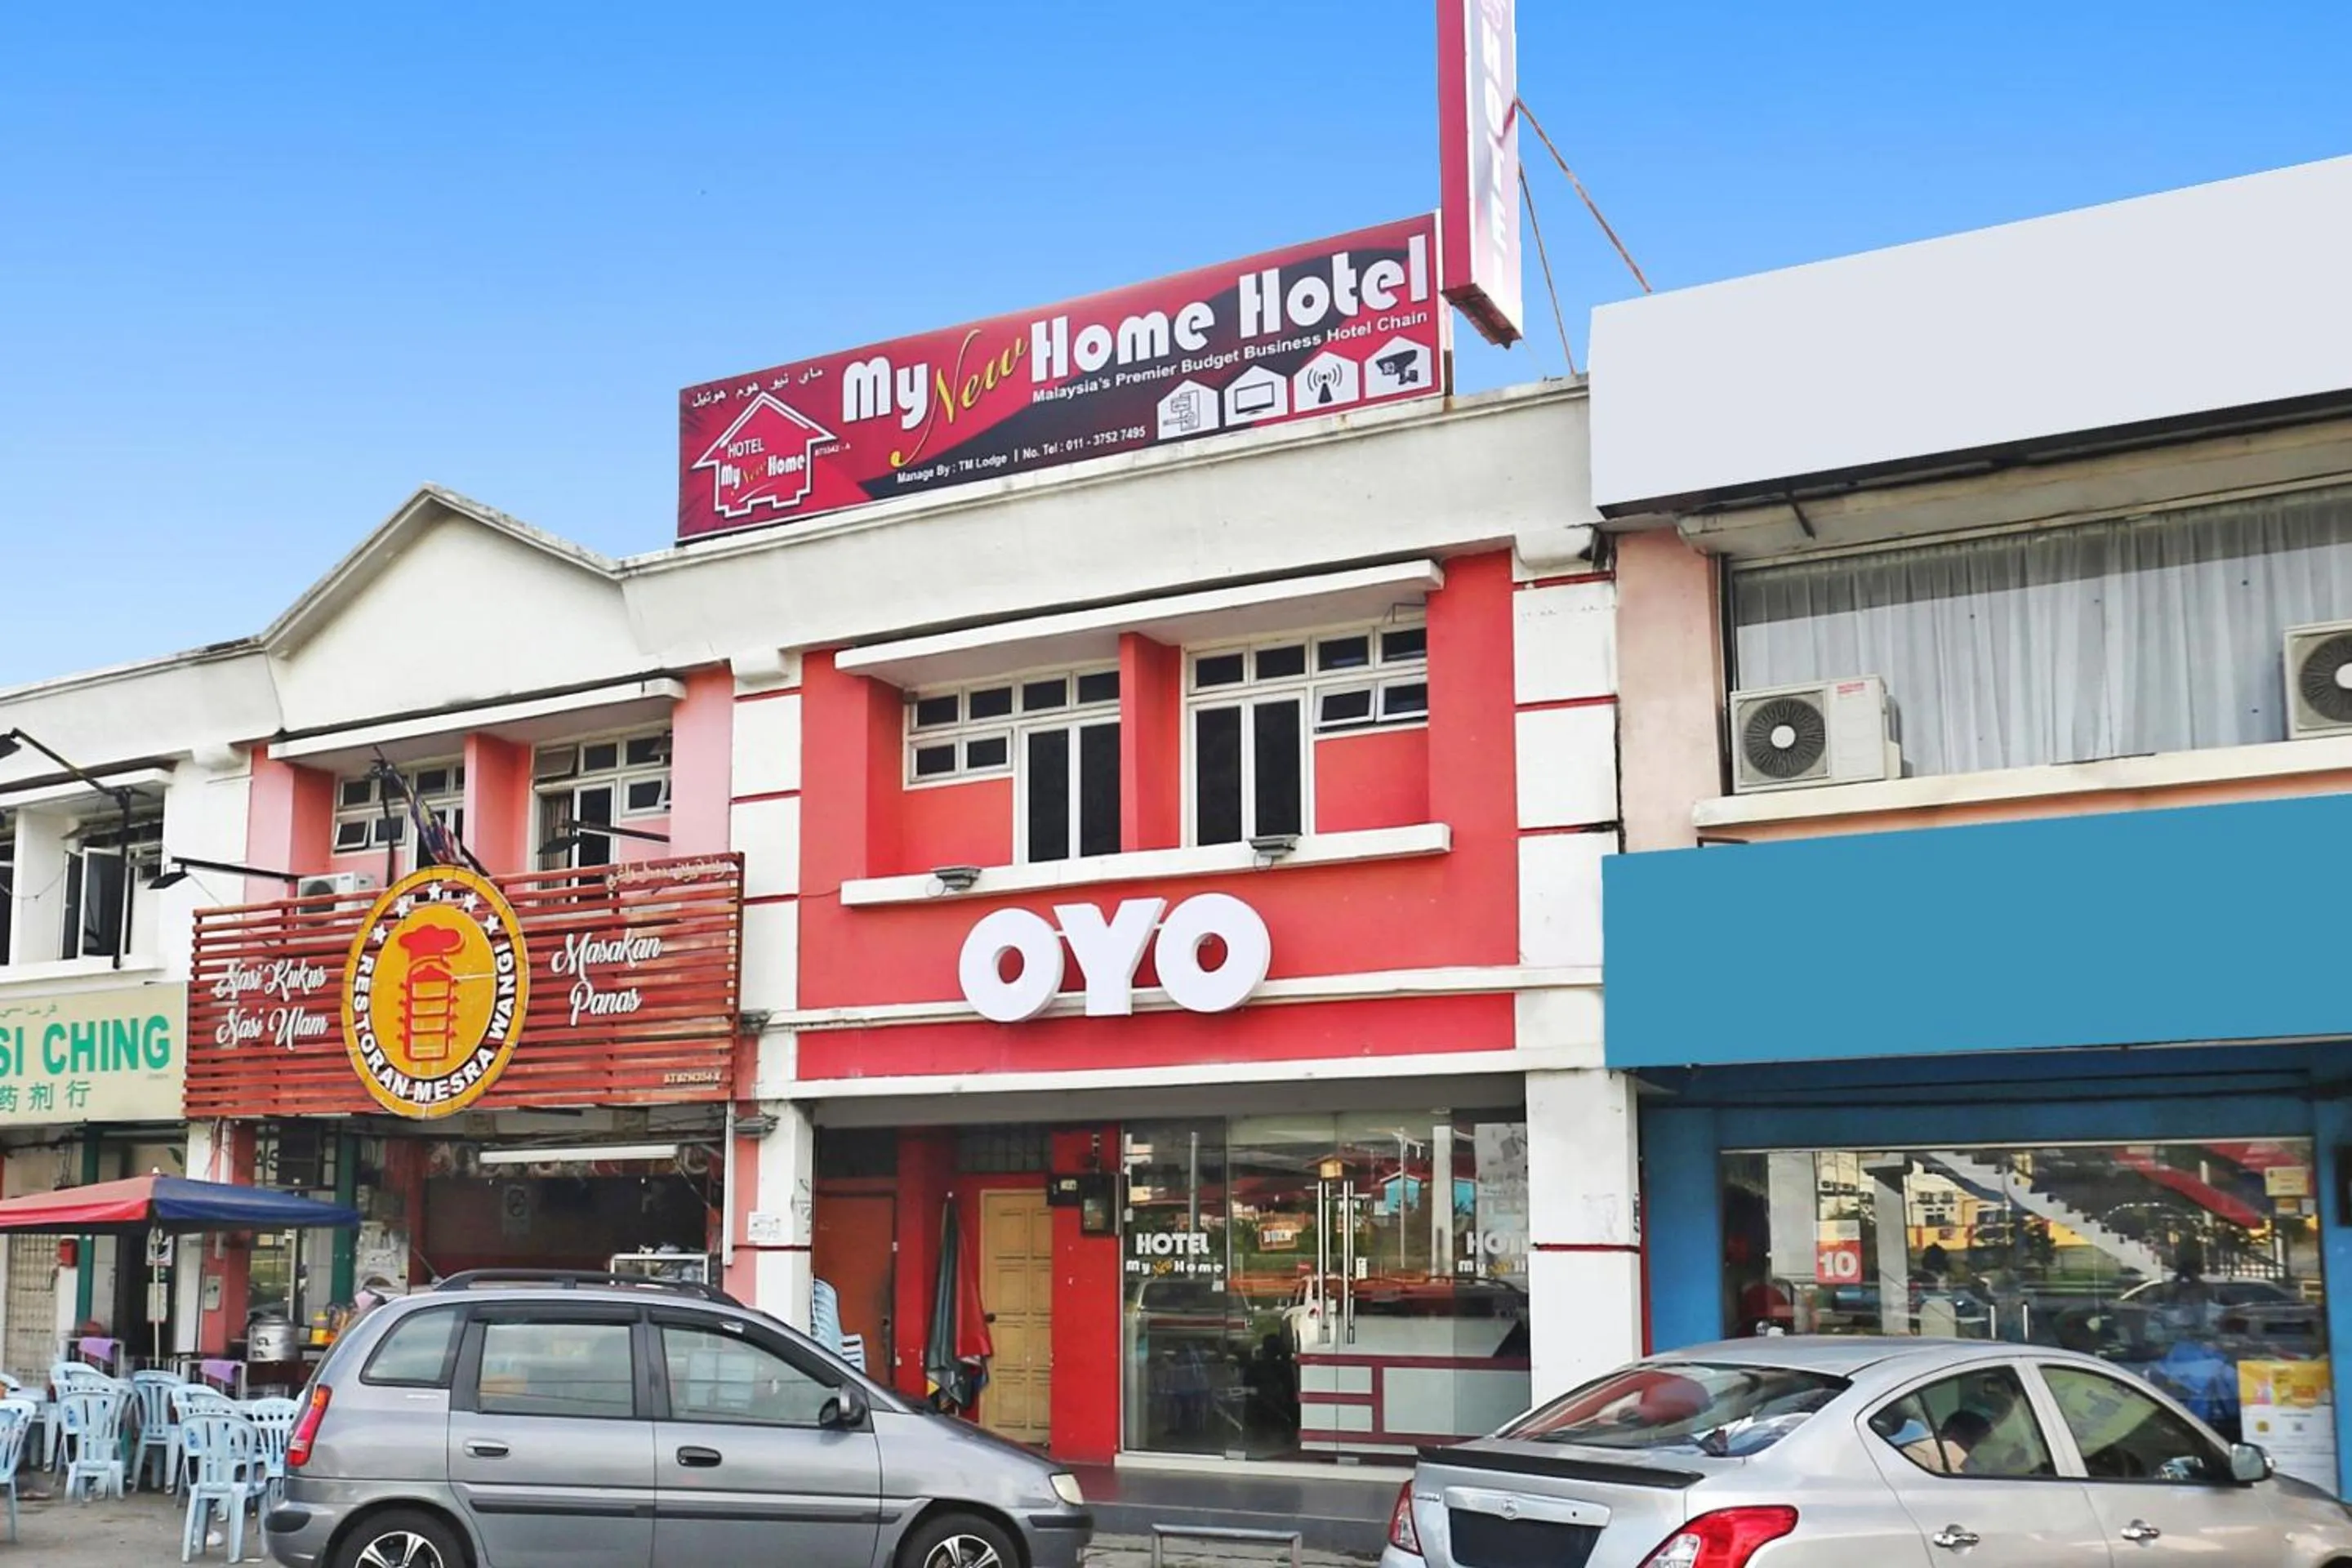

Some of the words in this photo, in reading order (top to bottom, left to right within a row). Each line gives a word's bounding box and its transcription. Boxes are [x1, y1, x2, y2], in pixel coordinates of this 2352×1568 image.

[842, 356, 929, 430] My
[889, 329, 1027, 467] New
[1031, 301, 1214, 383] Home
[1239, 234, 1428, 339] Hotel
[1032, 375, 1111, 403] Malaysia's
[1116, 365, 1177, 386] Premier
[1181, 350, 1240, 373] Budget
[1244, 333, 1322, 359] Business
[1327, 321, 1372, 342] Hotel
[1378, 310, 1428, 332] Chain
[728, 438, 764, 458] HOTEL
[1022, 448, 1039, 459] No.
[1066, 438, 1084, 451] 011
[1120, 425, 1146, 441] 7495
[721, 464, 741, 489] My
[768, 455, 805, 477] Home
[897, 468, 934, 483] Manage
[936, 465, 951, 478] By
[958, 459, 973, 471] TM
[975, 453, 1008, 469] Lodge
[551, 928, 663, 981] Masakan
[959, 893, 1272, 1022] OYO
[212, 963, 263, 999] Nasi
[264, 958, 327, 1002] Kukus
[354, 955, 409, 1098] RESTORAN
[413, 1047, 495, 1102] MESRA
[488, 942, 515, 1040] WANGI
[569, 981, 643, 1027] Panas
[42, 1015, 170, 1075] CHING
[216, 1008, 265, 1045] Nasi
[268, 1006, 328, 1051] Ulam
[1136, 1232, 1209, 1255] HOTEL
[1819, 1251, 1857, 1278] 10
[1125, 1260, 1151, 1276] My
[1174, 1260, 1224, 1273] Home
[1457, 1259, 1486, 1278] My
